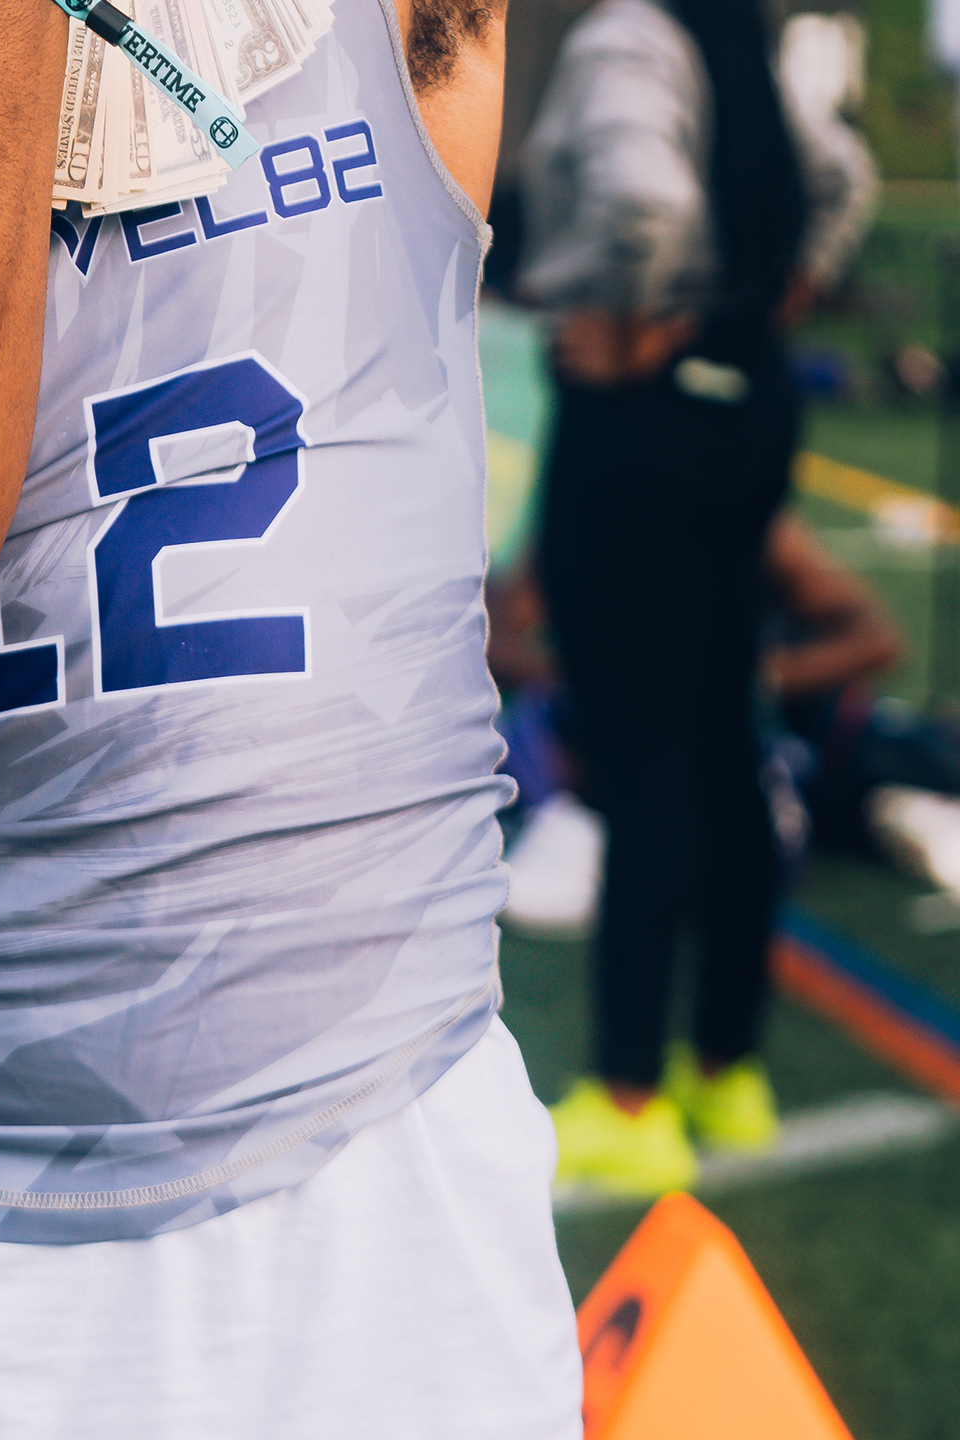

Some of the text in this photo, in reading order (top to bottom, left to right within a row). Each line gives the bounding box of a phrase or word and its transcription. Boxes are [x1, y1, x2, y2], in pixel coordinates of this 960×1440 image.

[233, 20, 242, 30] A
[224, 40, 234, 50] 2
[252, 40, 280, 70] 2
[56, 26, 88, 169] THE UNITED STATES
[68, 138, 91, 182] 10
